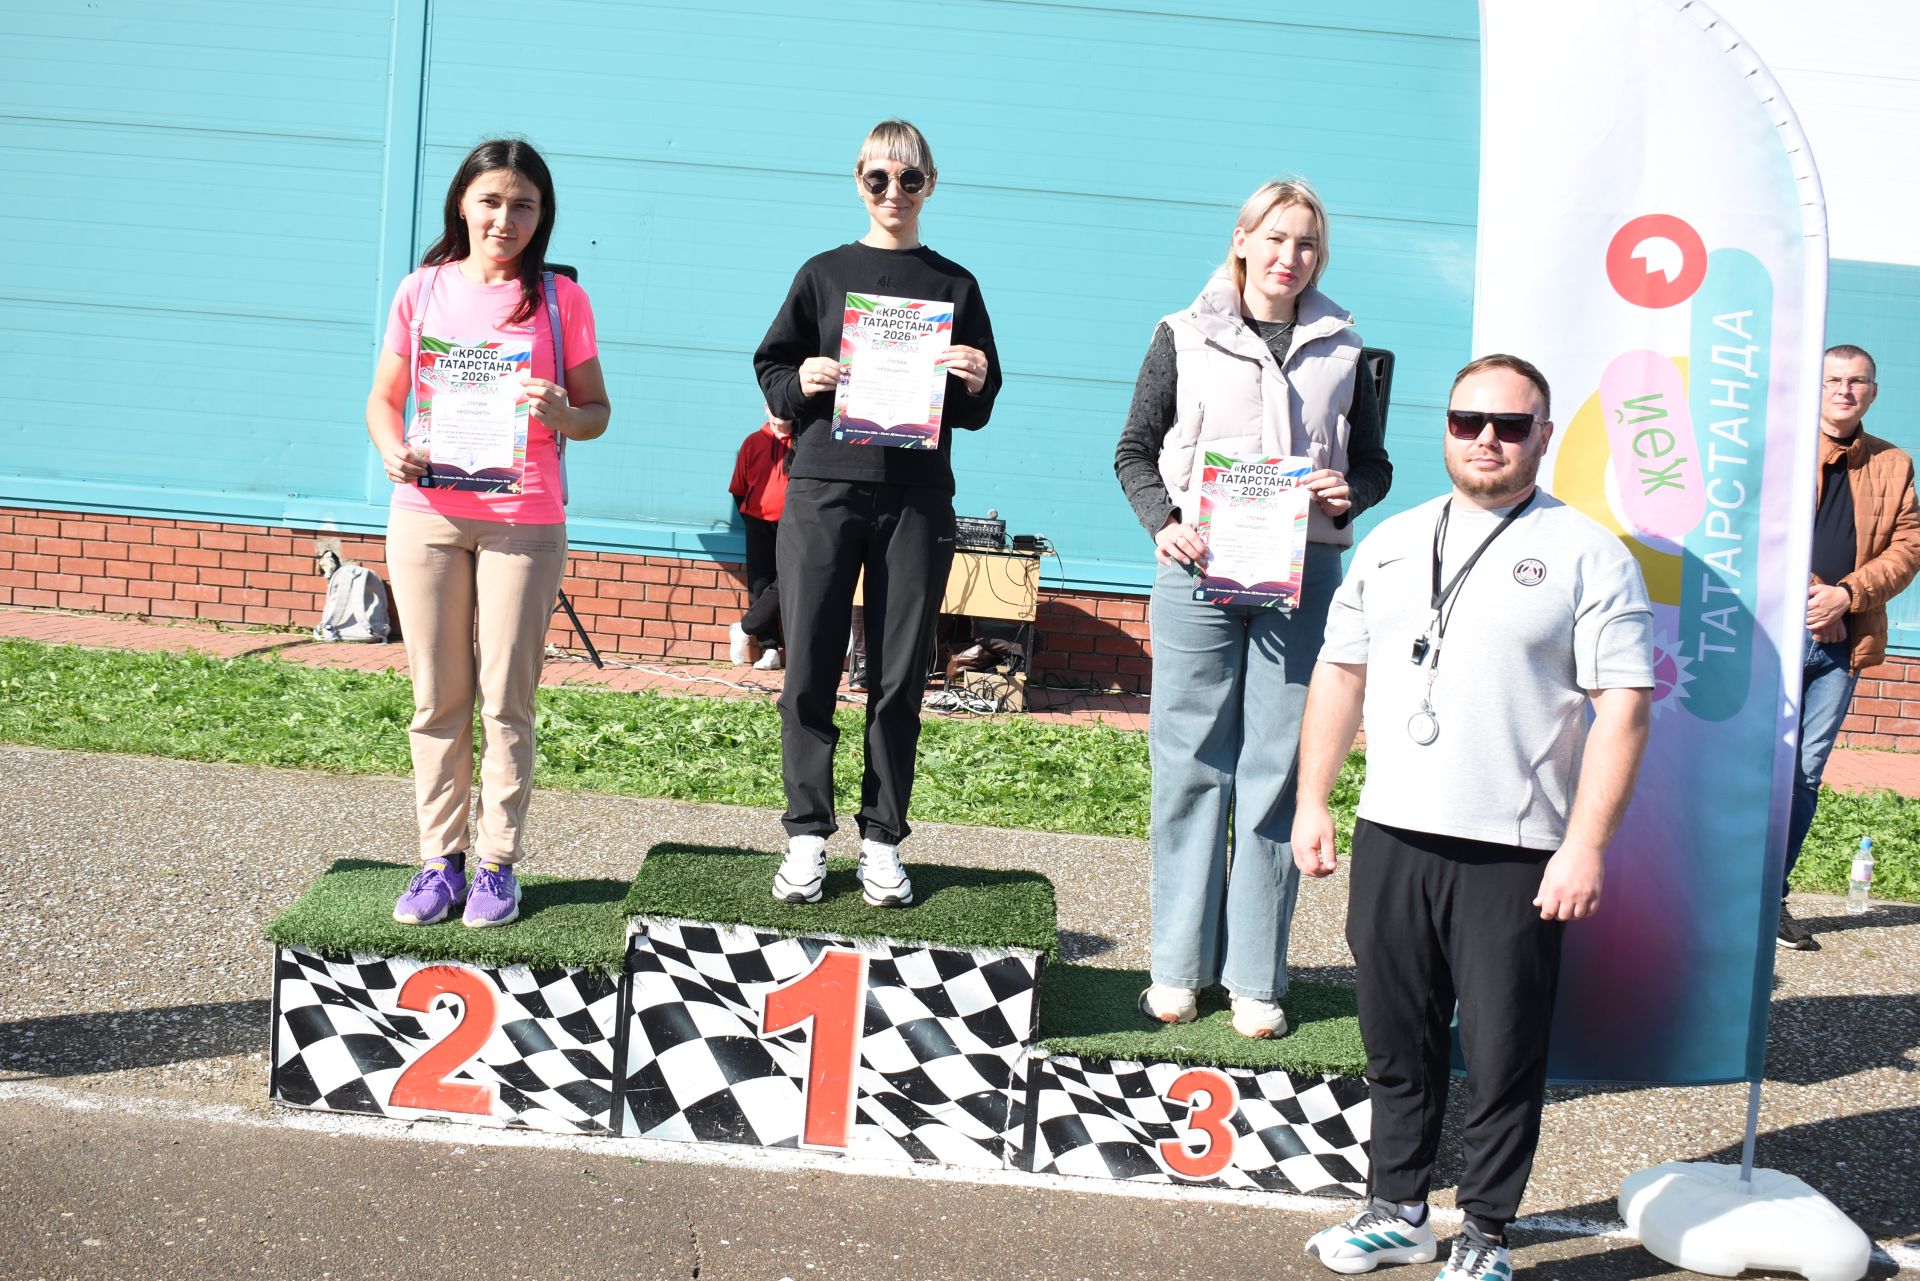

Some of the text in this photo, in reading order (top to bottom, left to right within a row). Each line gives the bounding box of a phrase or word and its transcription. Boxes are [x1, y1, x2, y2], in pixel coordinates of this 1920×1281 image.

[876, 308, 921, 320] «КРОСС
[863, 317, 933, 332] ТАТАРСТАНА
[883, 330, 917, 341] 2026»
[452, 349, 498, 360] «КРОСС
[439, 359, 512, 372] ТАТАРСТАНА
[461, 371, 496, 382] 2026»
[1234, 464, 1279, 475] «КРОСС
[1221, 474, 1292, 487] ТАТАРСТАНА
[1698, 309, 1760, 662] ТАТАРСТАНДА
[1241, 486, 1276, 497] 2026»
[387, 965, 497, 1117] 2
[762, 950, 866, 1148] 1
[1159, 1070, 1234, 1178] 3
